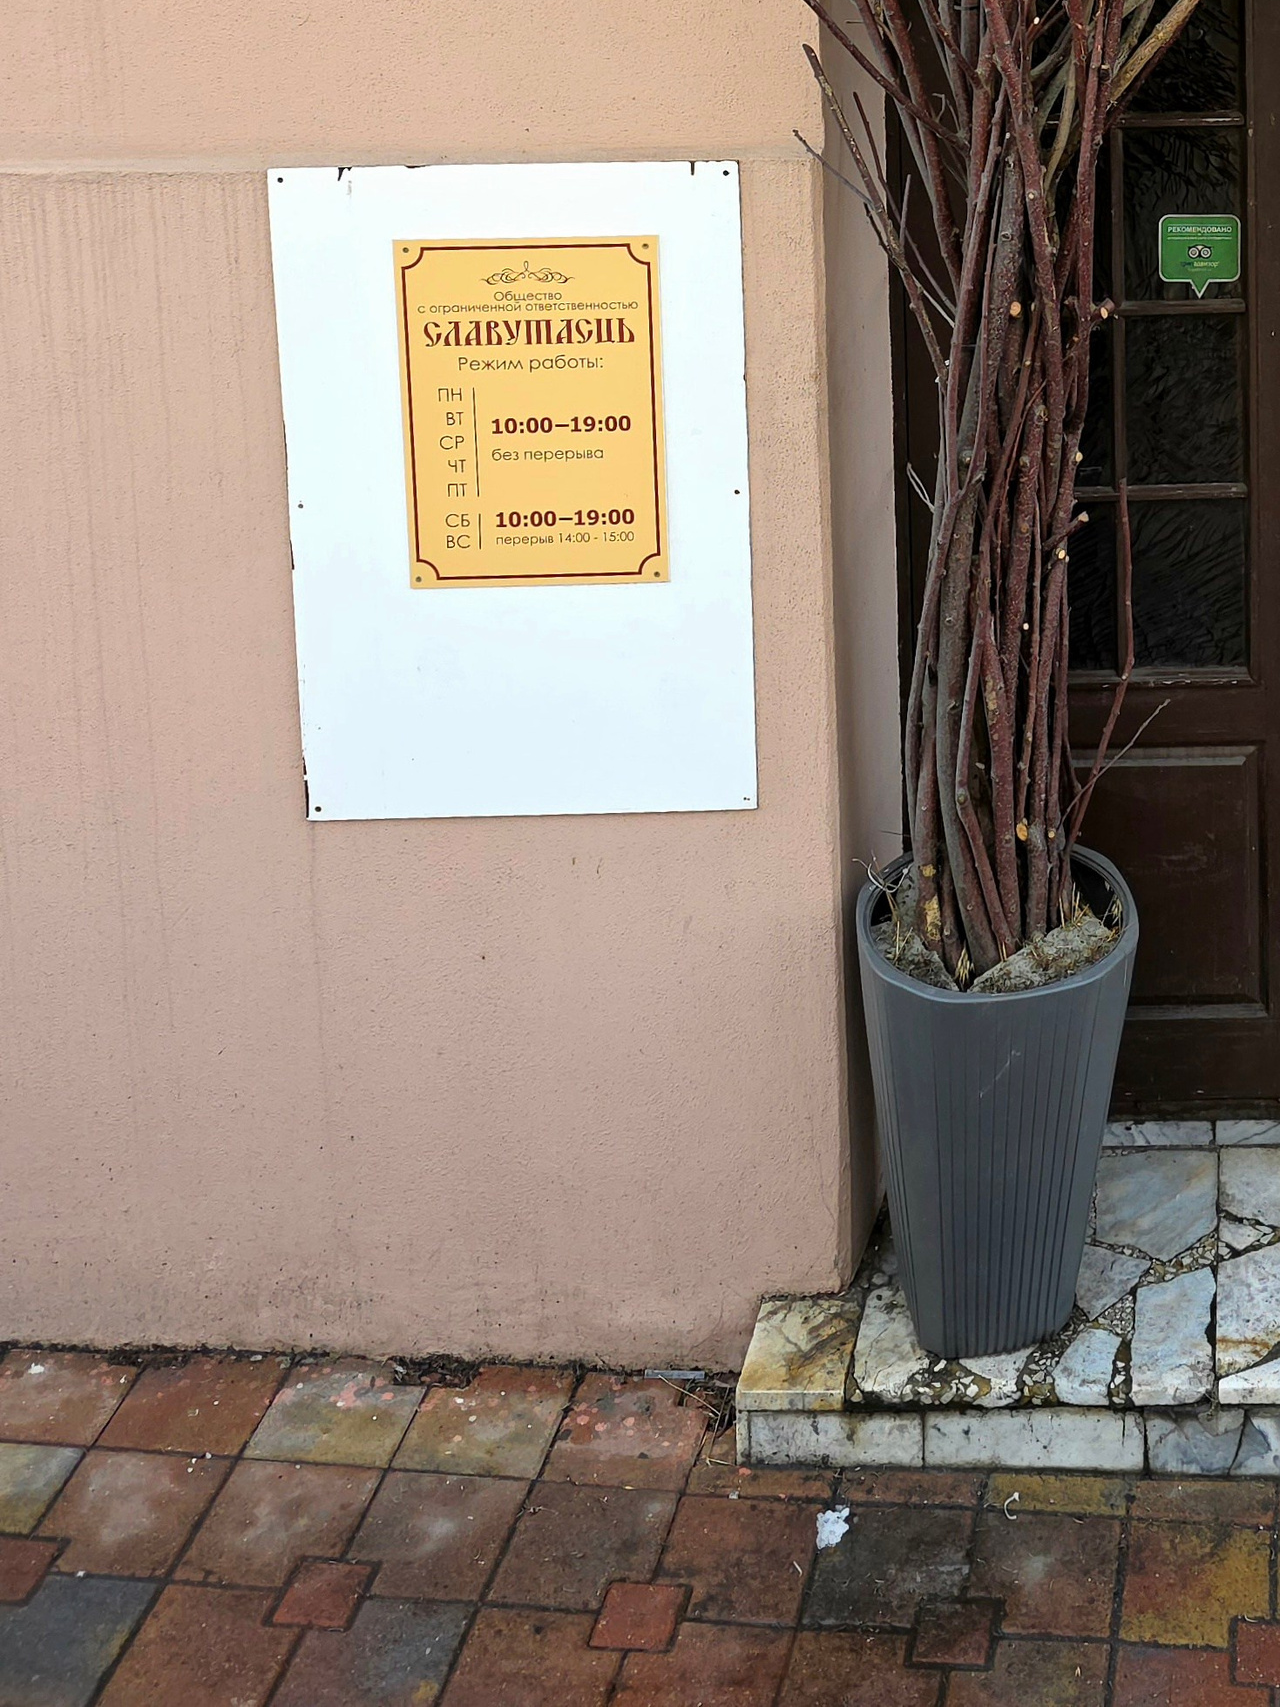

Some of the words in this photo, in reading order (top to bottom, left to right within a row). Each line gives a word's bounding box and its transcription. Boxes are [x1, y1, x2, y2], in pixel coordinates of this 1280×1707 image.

[494, 291, 562, 303] Общество
[430, 302, 521, 315] ограниченной
[524, 299, 638, 311] ответственностью
[459, 357, 523, 370] Режим
[530, 355, 603, 372] работы:
[438, 388, 462, 402] ПН
[446, 412, 464, 425] ВТ
[440, 436, 464, 450] СР
[492, 449, 519, 461] без
[524, 449, 603, 462] перерыва
[448, 459, 466, 473] ЧТ
[448, 483, 467, 497] ПТ
[446, 514, 470, 527] СБ
[447, 535, 470, 548] ВС
[496, 536, 554, 546] перерыв
[560, 533, 590, 543] 14:00
[604, 531, 634, 542] 15:00
